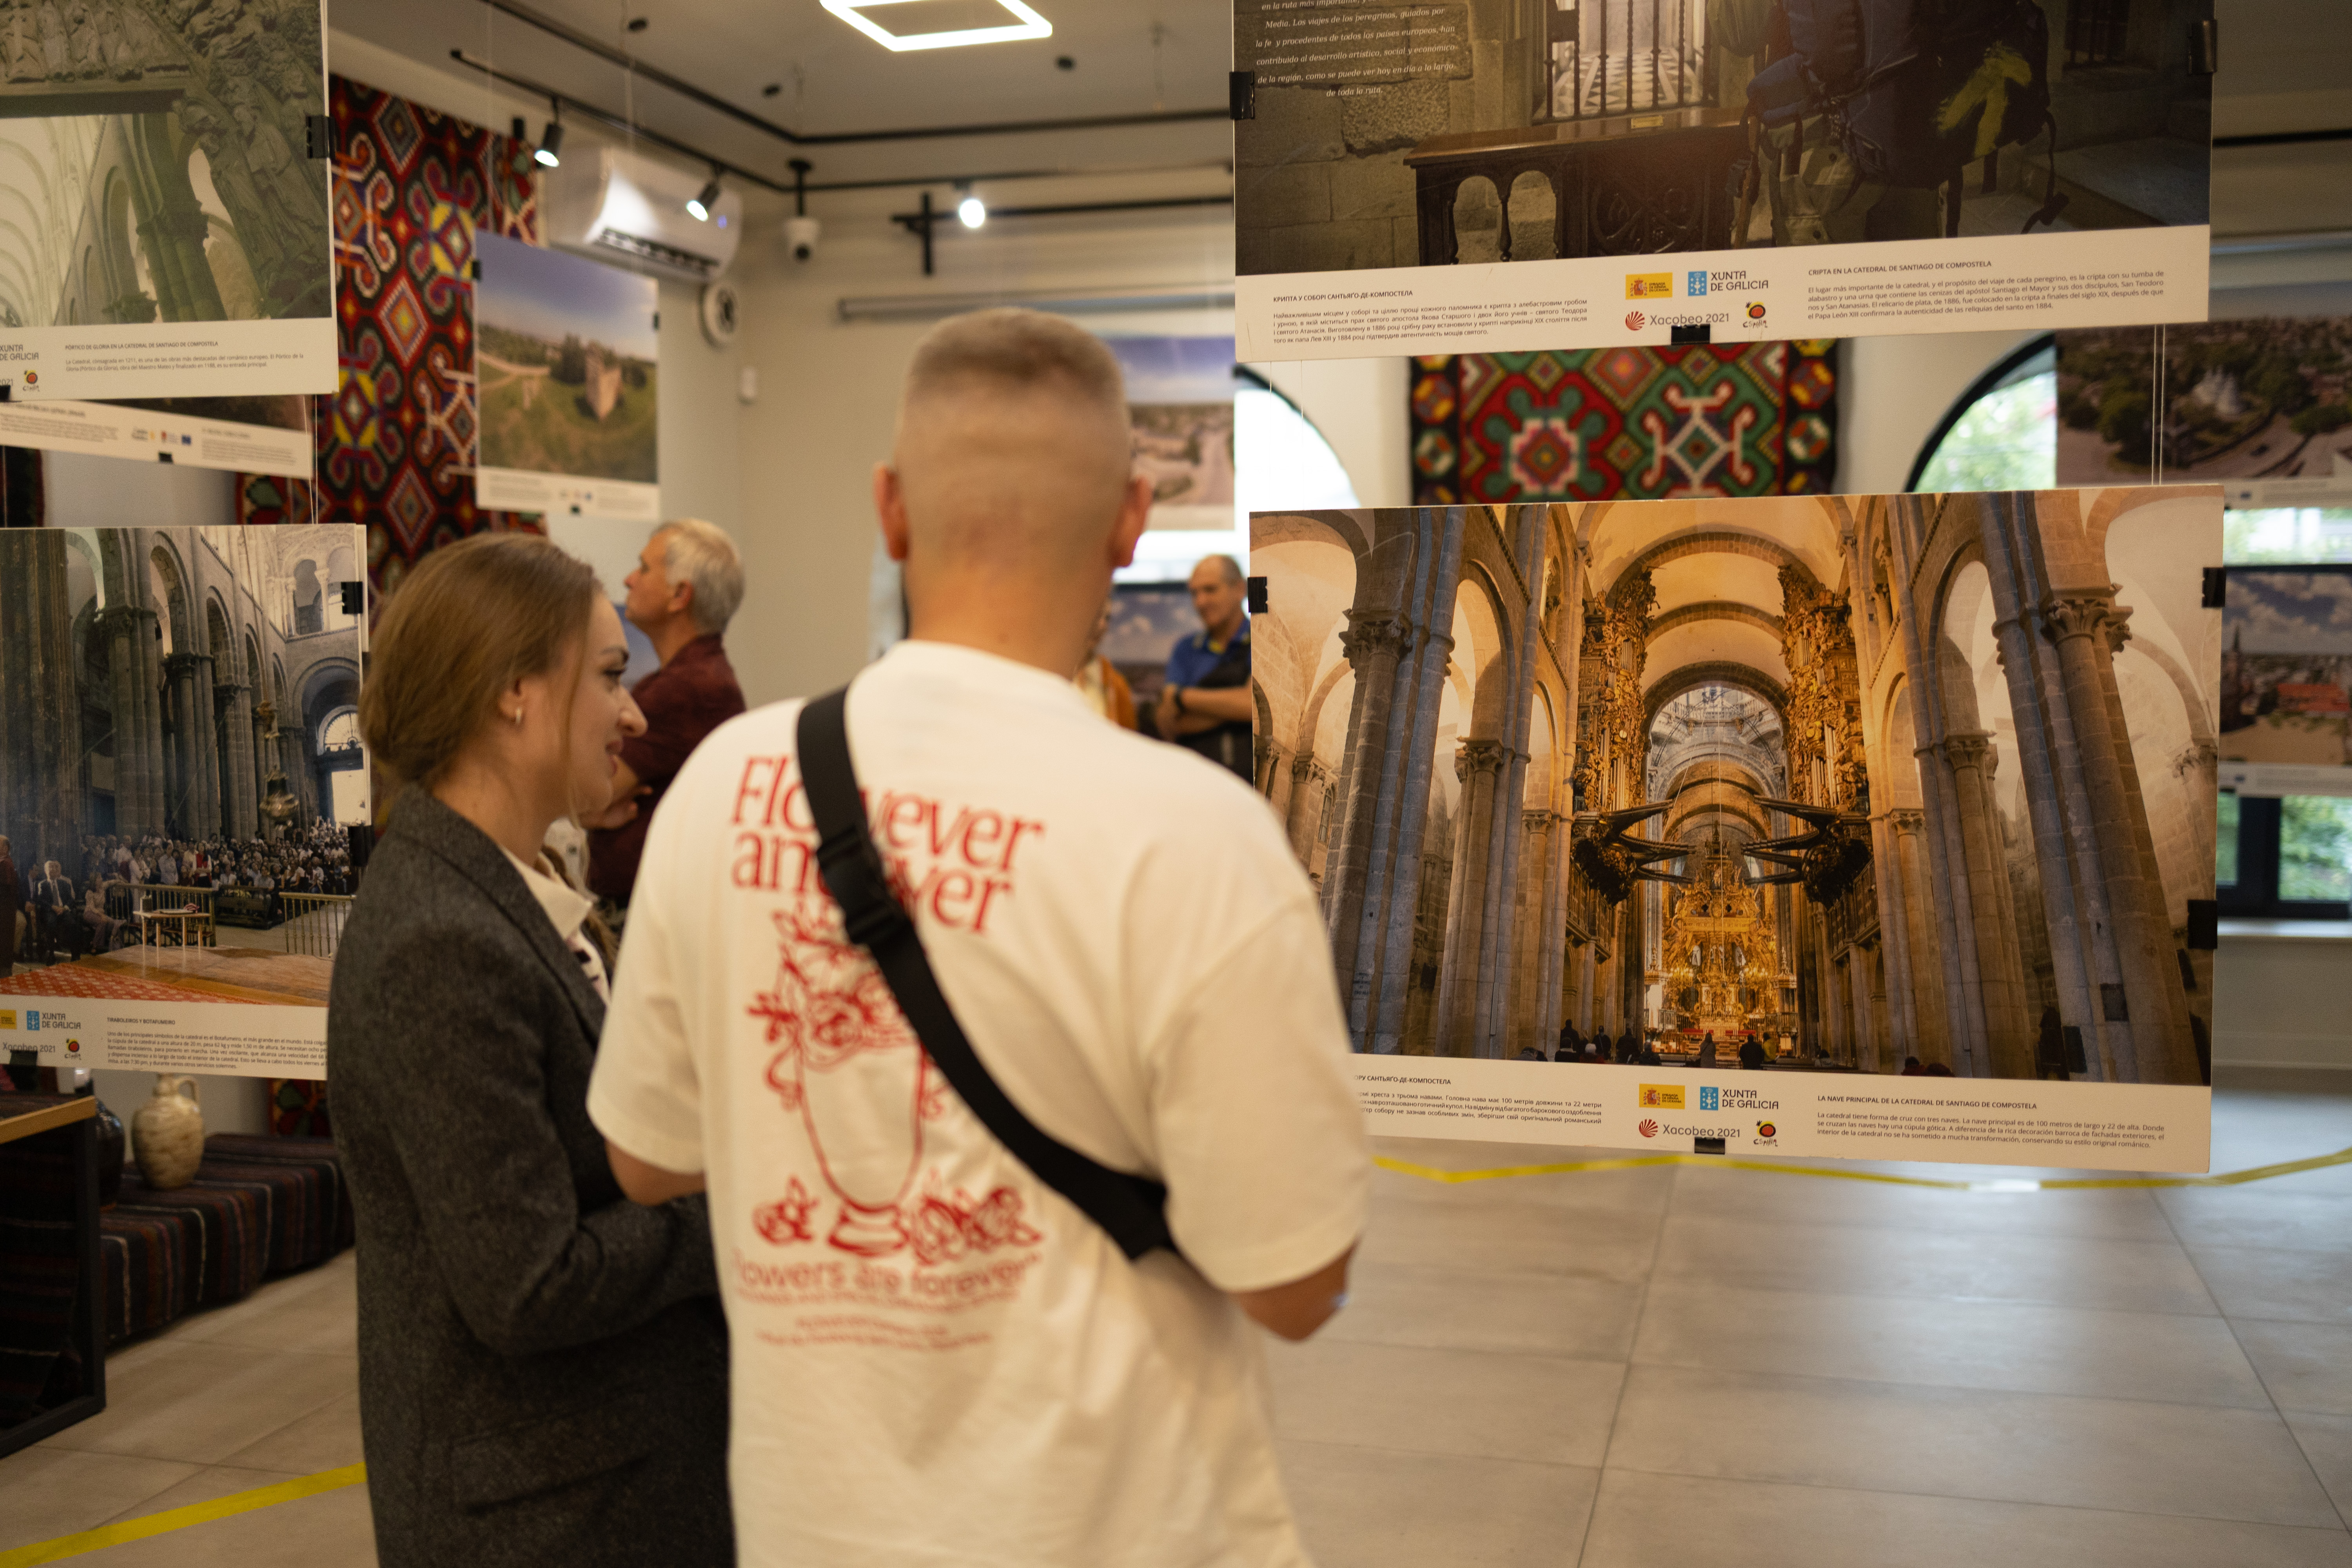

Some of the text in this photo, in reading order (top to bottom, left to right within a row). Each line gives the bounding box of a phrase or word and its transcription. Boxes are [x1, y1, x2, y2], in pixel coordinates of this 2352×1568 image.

[1266, 20, 1290, 29] Media.
[1293, 18, 1306, 27] Los
[1308, 17, 1329, 26] viajes
[1355, 12, 1398, 23] peregrinos,
[1400, 9, 1430, 19] guiados
[1432, 8, 1445, 16] por
[1264, 39, 1271, 48] fe
[1282, 36, 1327, 47] procedentes
[1341, 33, 1361, 41] todos
[1376, 30, 1399, 39] países
[1401, 27, 1438, 36] europeos,
[1256, 55, 1298, 65] contribuido
[1301, 54, 1307, 62] al
[1309, 52, 1347, 62] desarrollo
[1349, 50, 1382, 59] artístico,
[1384, 47, 1406, 56] social
[1414, 44, 1455, 54] económico
[1278, 73, 1303, 83] región,
[1338, 69, 1361, 79] puede
[1377, 67, 1390, 76] hoy
[1434, 63, 1454, 71] largo
[1327, 89, 1336, 97] de
[1338, 88, 1354, 96] toda
[1945, 261, 1991, 269] COMPOSTELA
[1711, 271, 1746, 281] XUNTA
[1711, 280, 1769, 291] DE GALICIA
[1327, 290, 1413, 299] САНТЬЯҐО-ДЕ-КОМПОСТЕЛА
[1650, 313, 1729, 325] Xacobeo 2021
[53, 1021, 81, 1029] GALICIA
[1367, 1076, 1451, 1085] САНТЬЯҐО-ДЕ-КОМПОСТЕЛА
[1722, 1089, 1757, 1098] XUNTA
[1722, 1099, 1779, 1110] DE GALICIA
[1662, 1124, 1740, 1137] Xacobeo 2021
[1970, 1135, 2020, 1143] transformación,
